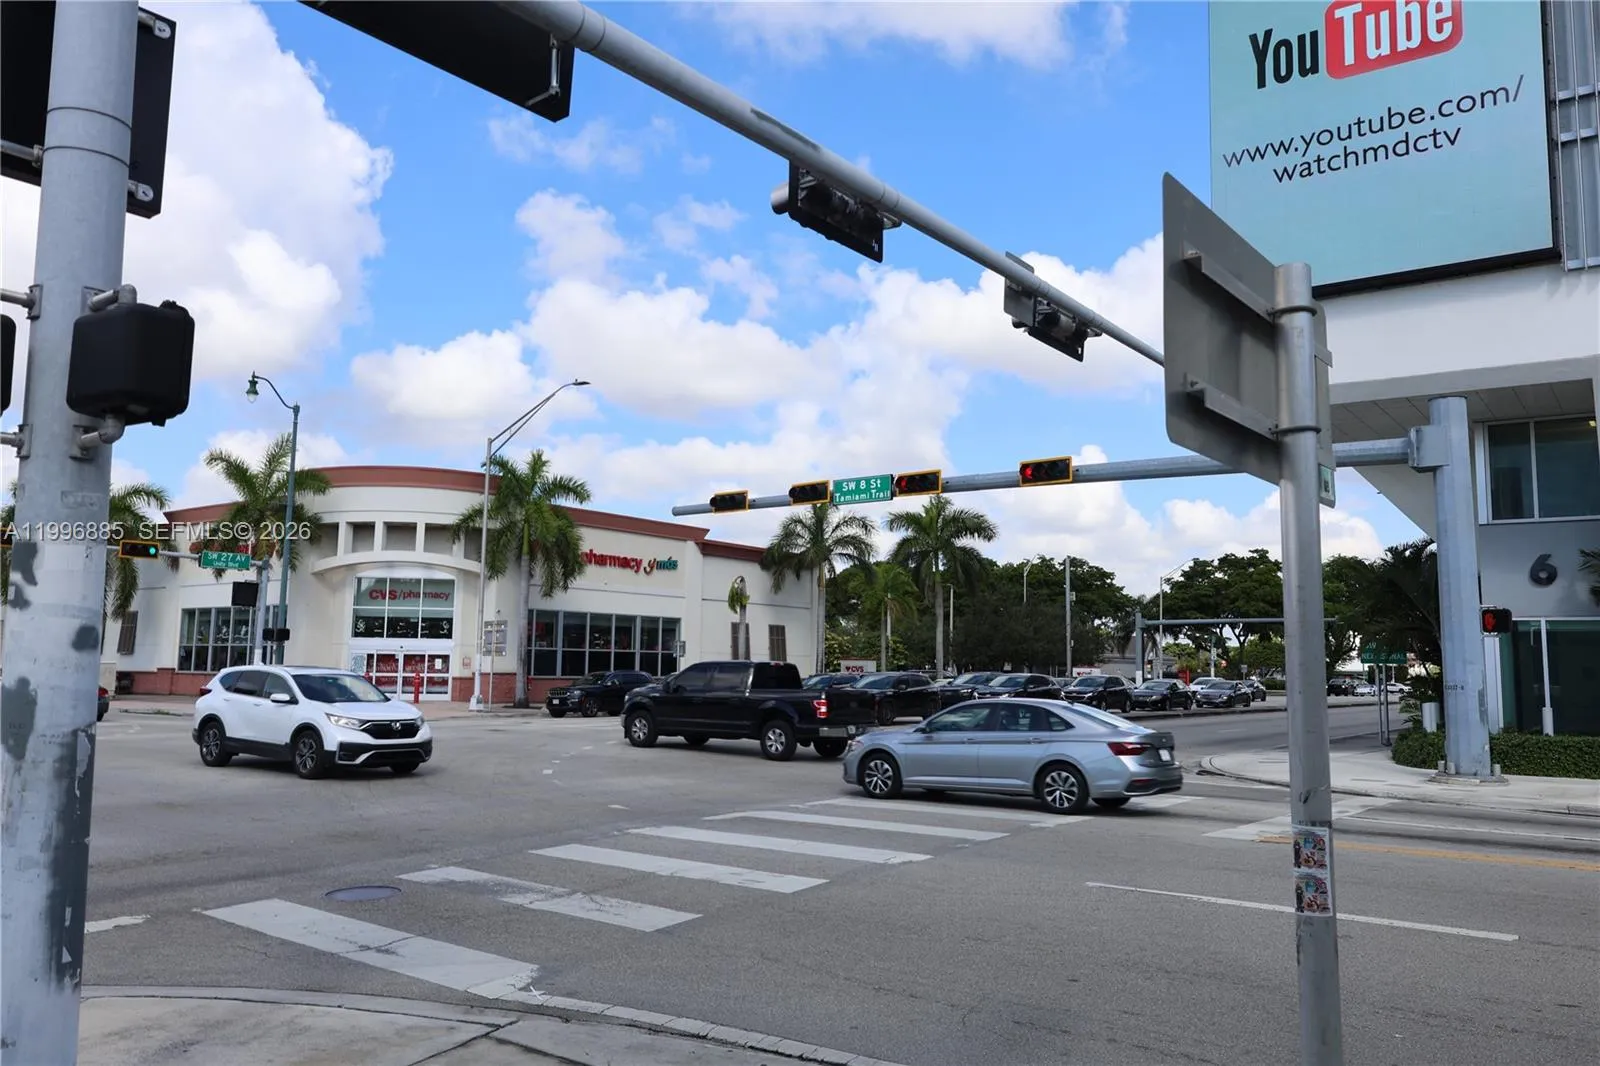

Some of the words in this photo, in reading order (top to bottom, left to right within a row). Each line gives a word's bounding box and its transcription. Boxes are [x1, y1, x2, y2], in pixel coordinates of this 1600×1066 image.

[1222, 74, 1525, 169] www.youtube.com/
[1273, 126, 1462, 184] watchmdctv
[834, 491, 870, 502] Tamiami
[870, 489, 890, 499] Trail
[842, 481, 856, 491] SW
[860, 480, 866, 489] 8
[870, 478, 881, 489] St
[221, 552, 233, 561] 27
[236, 554, 246, 562] AV
[1529, 553, 1558, 587] 6
